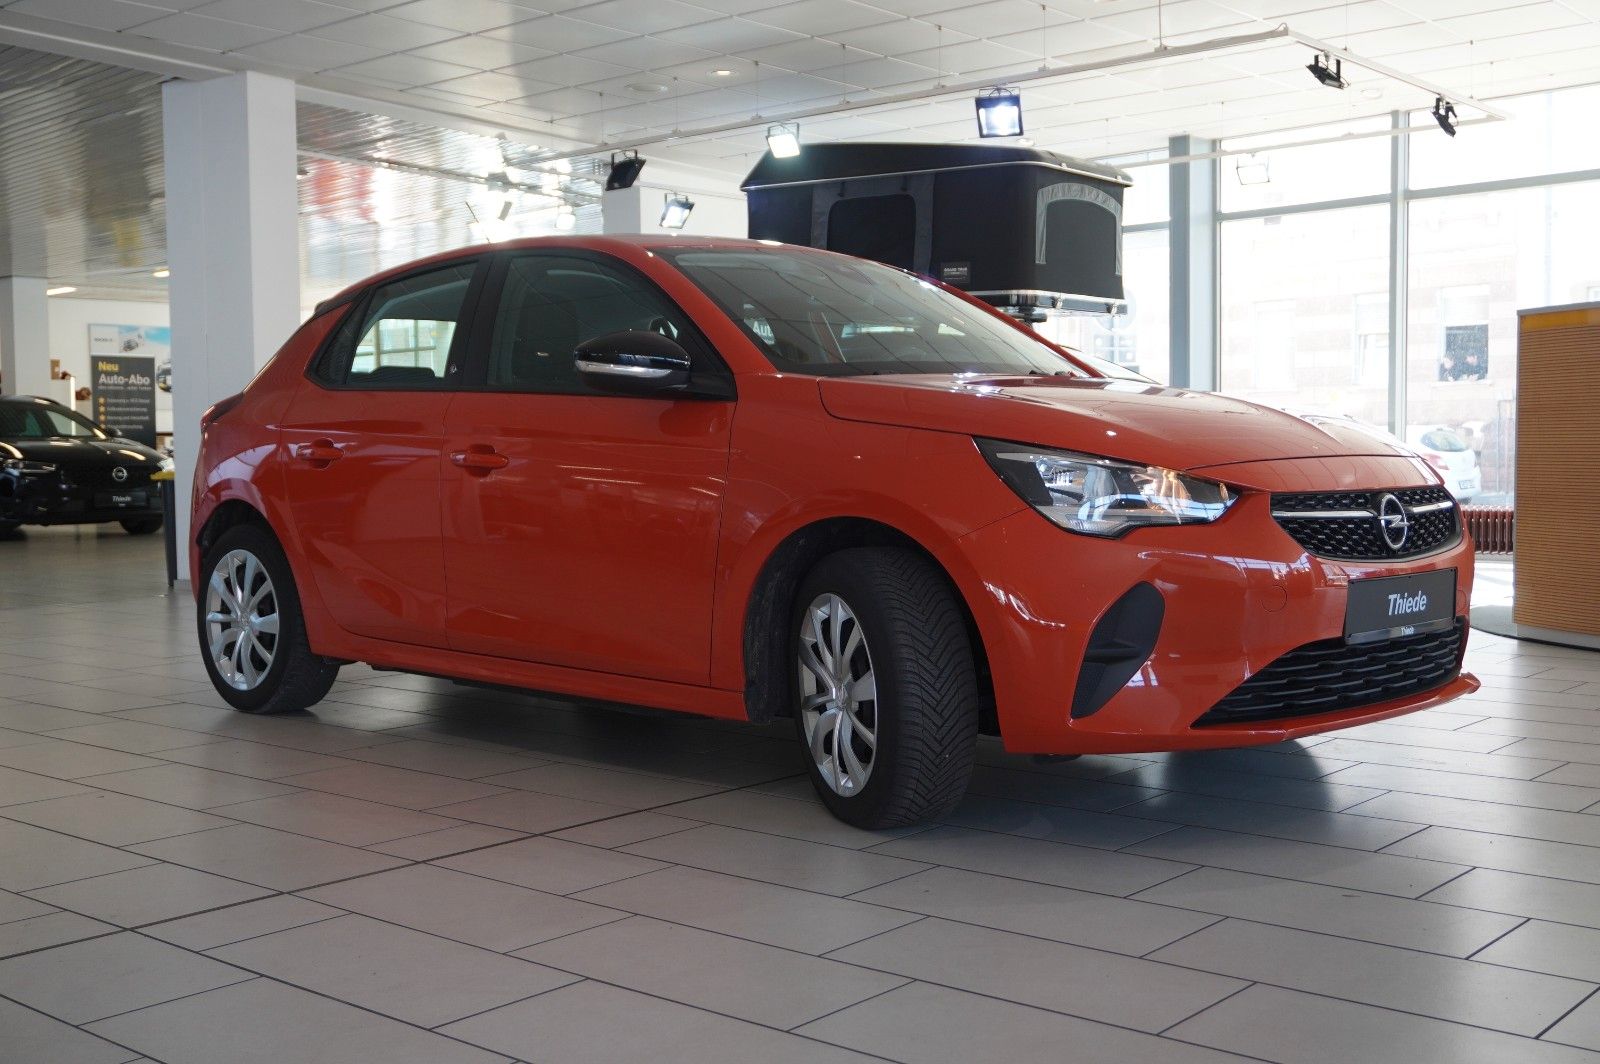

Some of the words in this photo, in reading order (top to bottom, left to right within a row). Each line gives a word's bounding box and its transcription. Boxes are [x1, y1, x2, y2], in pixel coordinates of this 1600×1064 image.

[98, 361, 120, 372] Neu
[98, 373, 151, 386] Auto-Abo
[1388, 590, 1427, 616] Thiede
[1401, 625, 1415, 636] Thiede
